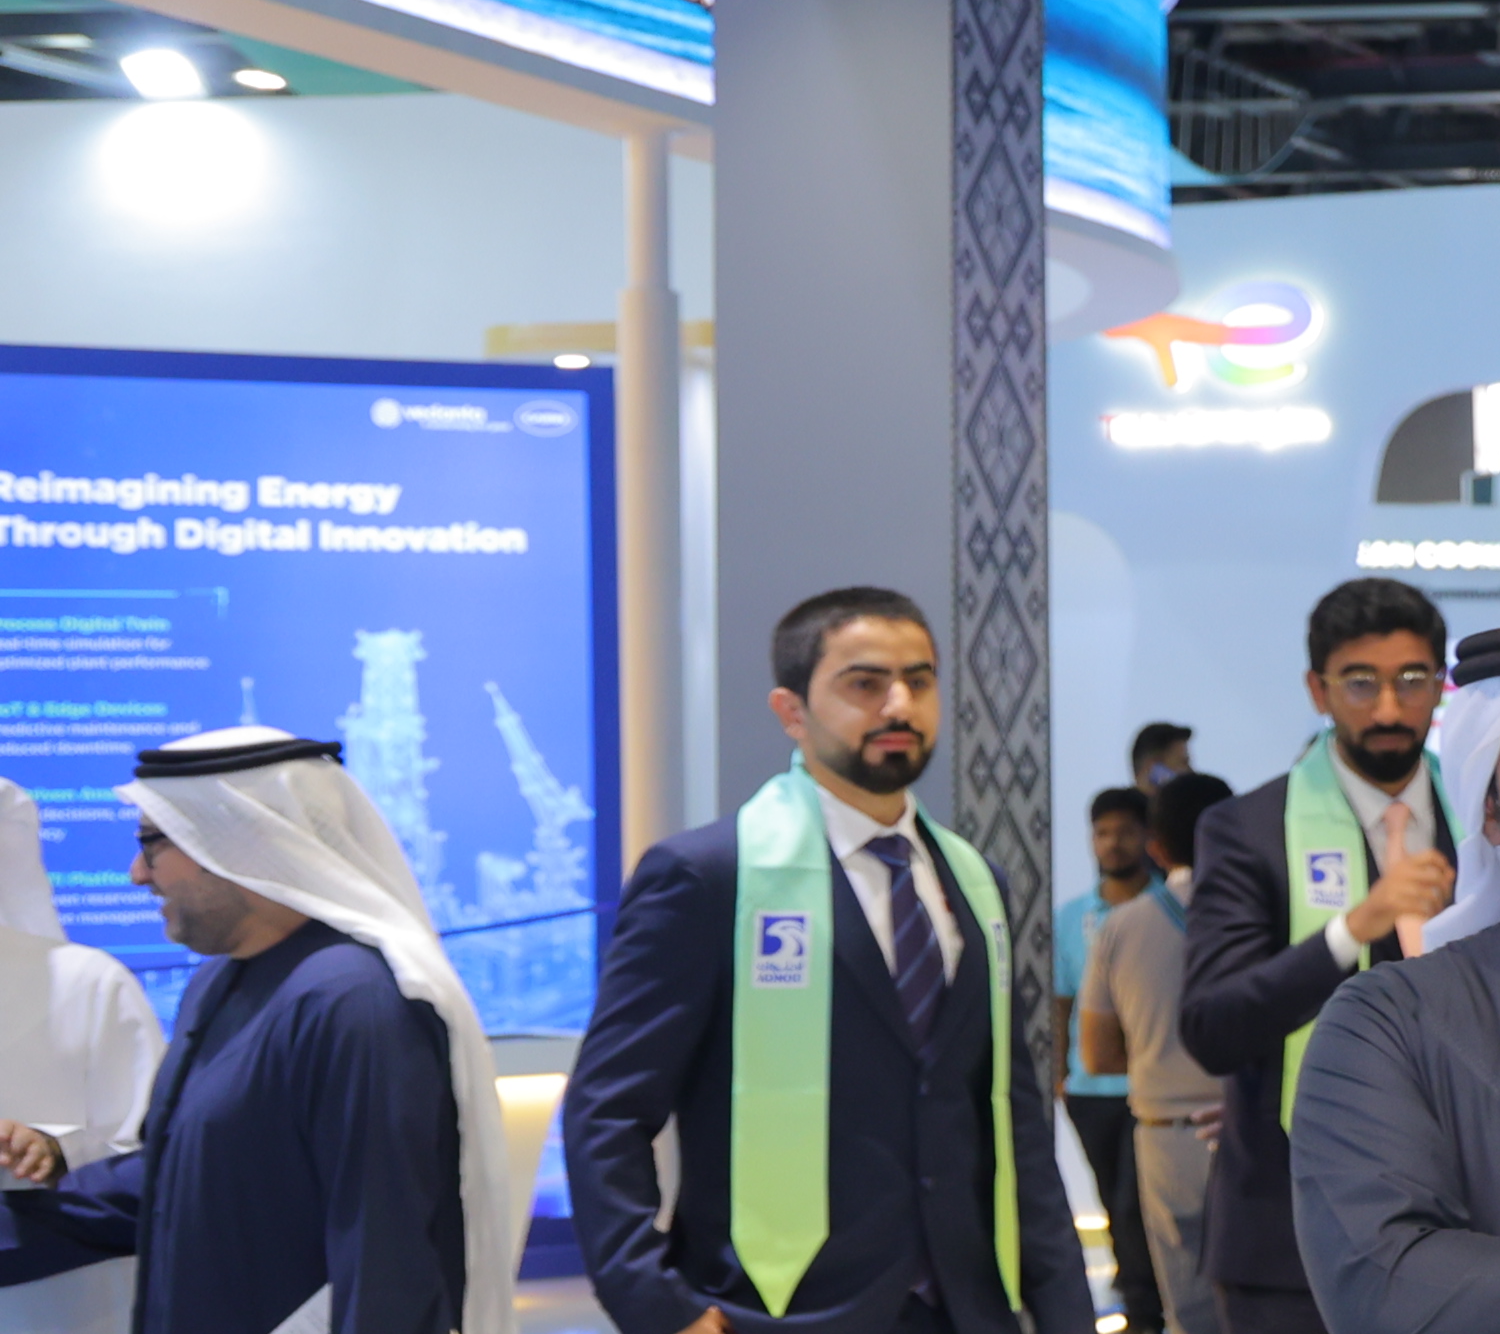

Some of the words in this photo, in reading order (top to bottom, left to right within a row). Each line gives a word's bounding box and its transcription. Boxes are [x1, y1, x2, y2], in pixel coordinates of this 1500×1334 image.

[257, 474, 402, 515] Energy
[0, 514, 166, 554] Through
[175, 516, 311, 555] Digital
[319, 519, 529, 554] Innovation
